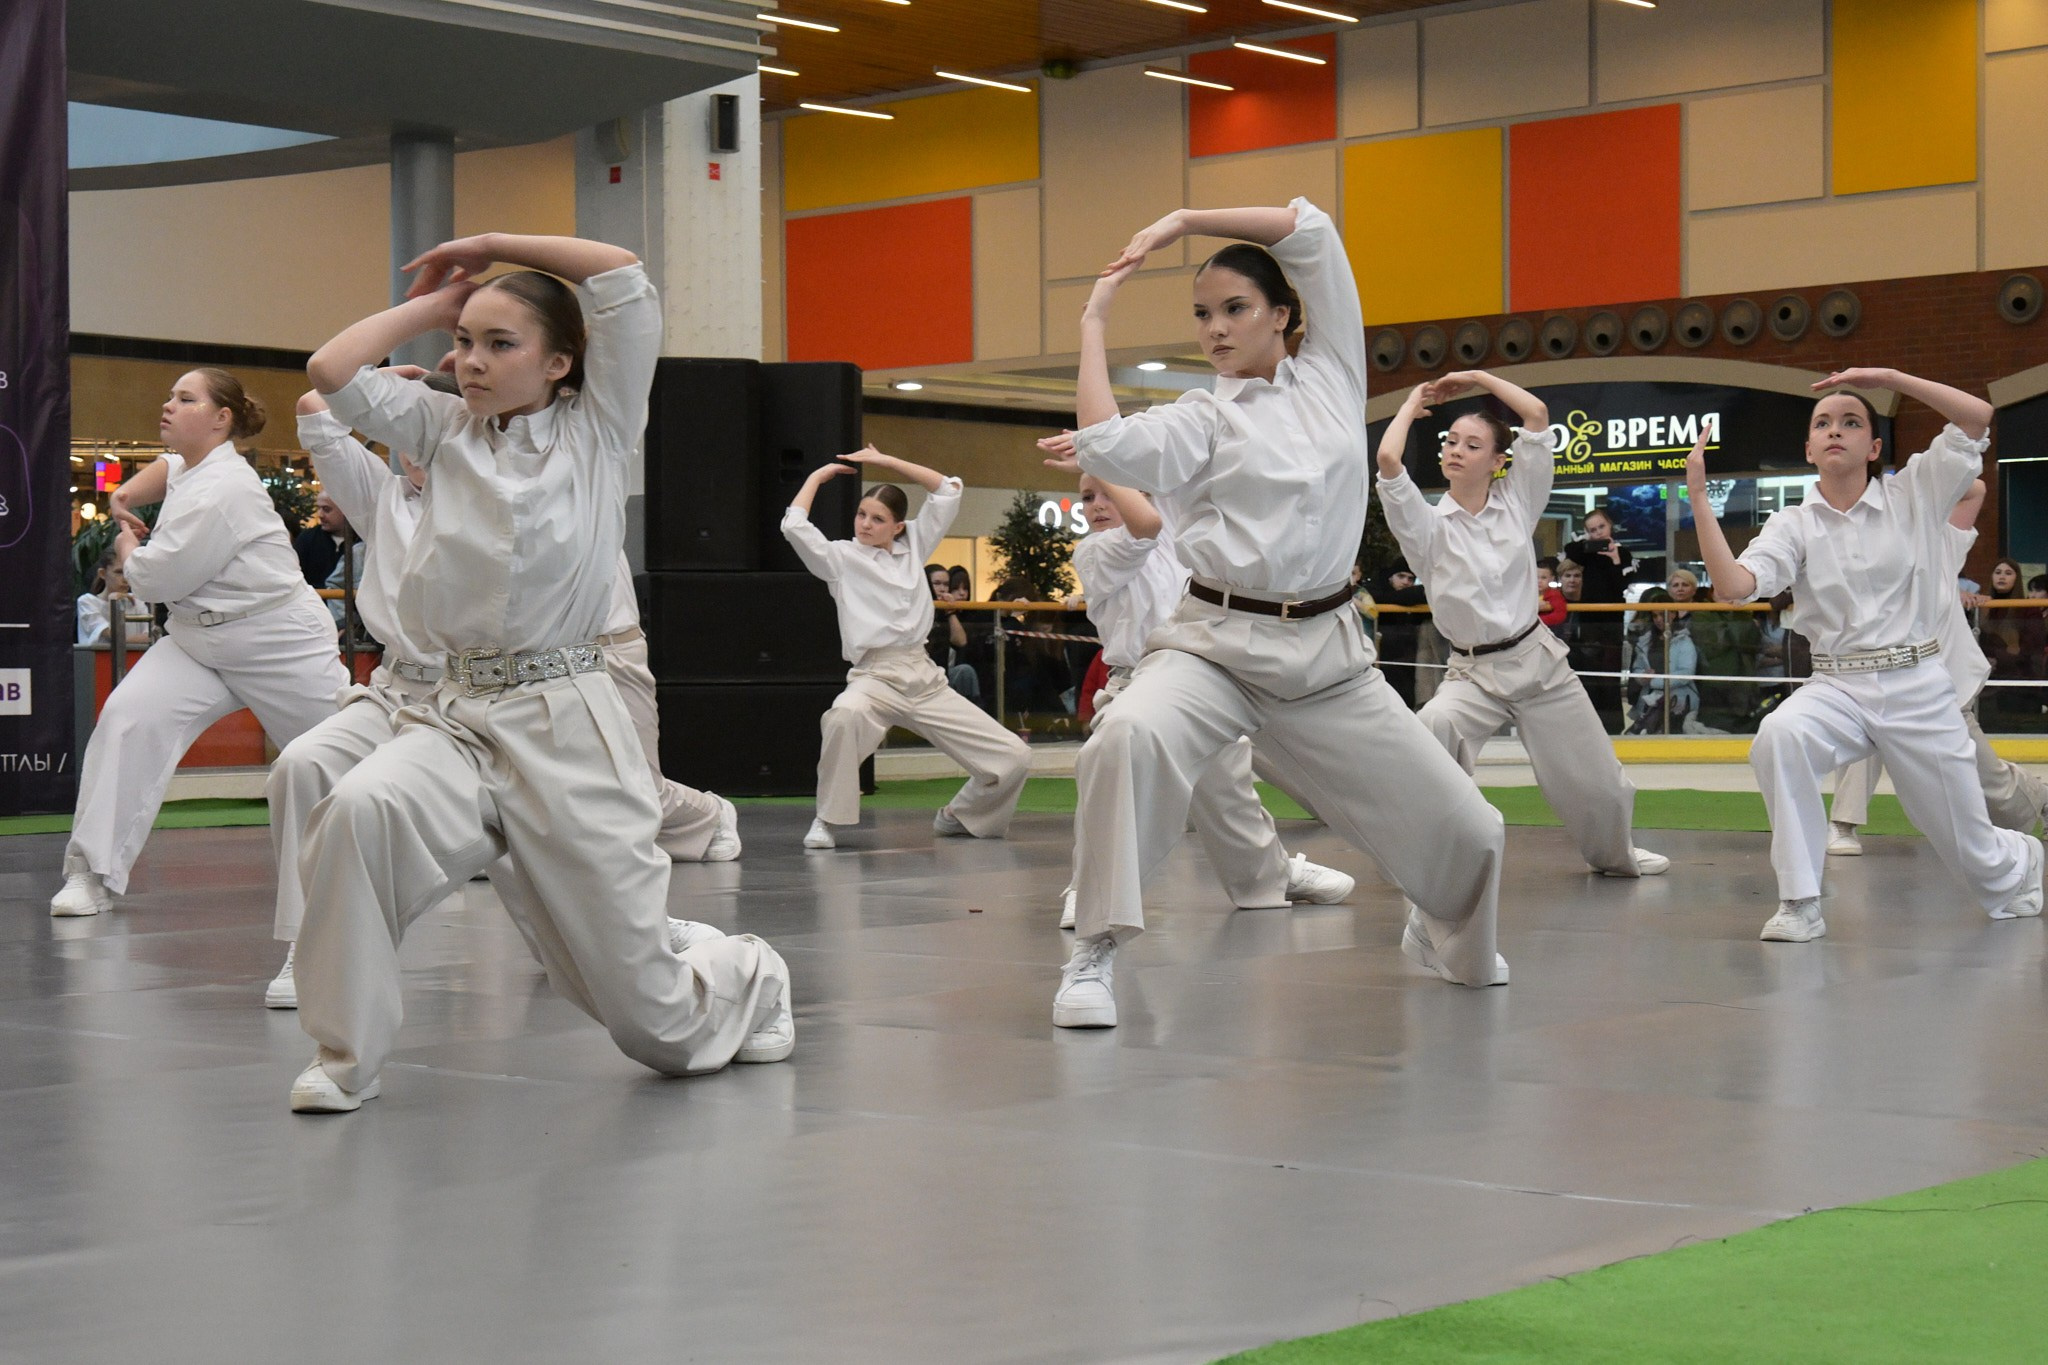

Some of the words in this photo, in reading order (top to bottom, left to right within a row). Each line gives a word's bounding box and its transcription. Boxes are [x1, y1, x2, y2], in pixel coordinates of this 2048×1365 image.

[1607, 412, 1721, 449] ВРЕМЯ
[1600, 460, 1653, 473] МАГАЗИН
[1658, 458, 1687, 469] ЧАСО
[1038, 497, 1090, 535] O'S
